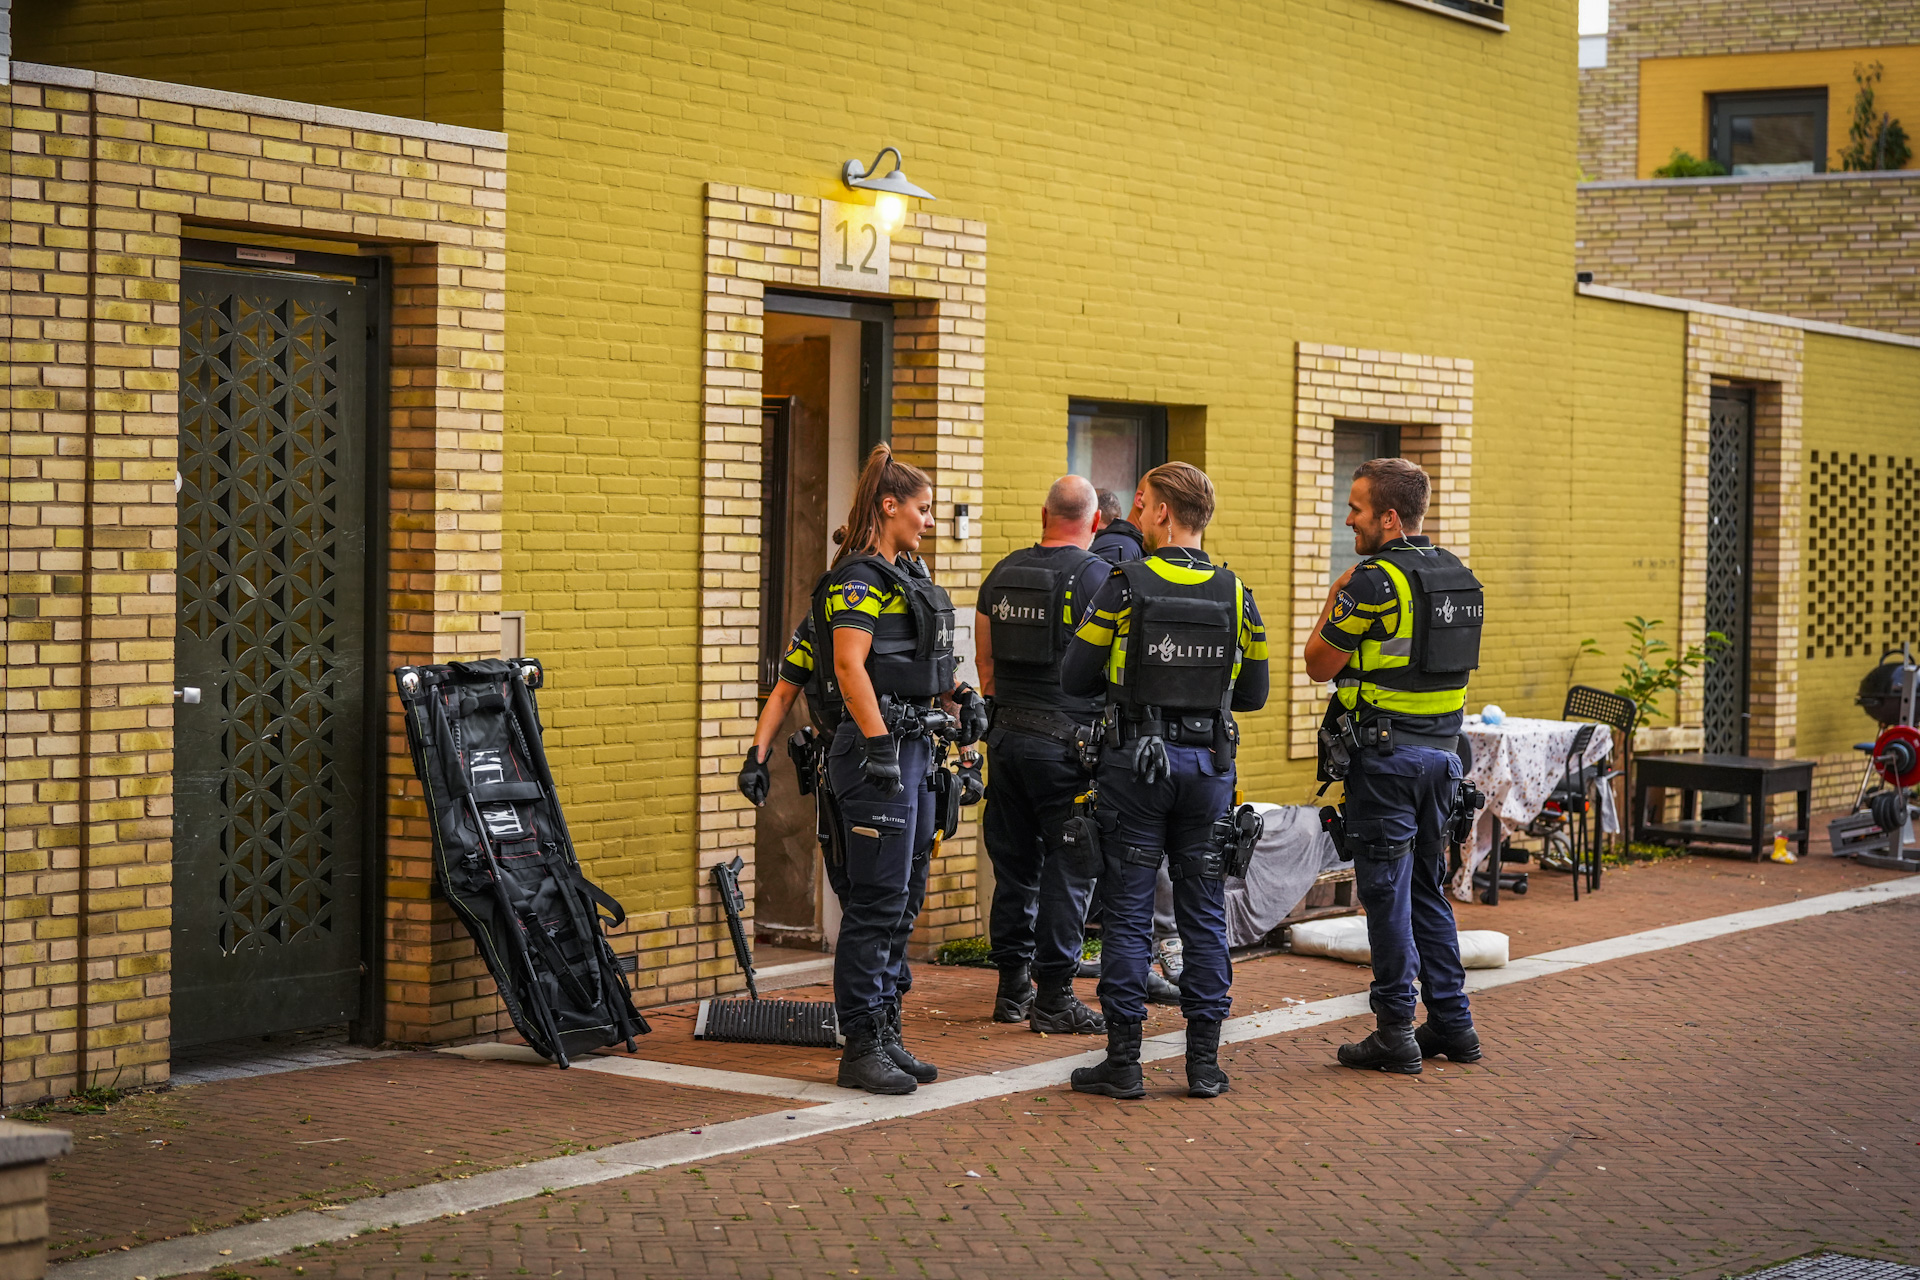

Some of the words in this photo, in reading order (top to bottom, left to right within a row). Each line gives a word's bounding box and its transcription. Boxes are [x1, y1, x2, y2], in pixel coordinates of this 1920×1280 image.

[835, 220, 878, 275] 12
[992, 600, 1045, 620] POLITIE
[1148, 640, 1225, 661] POLITIE
